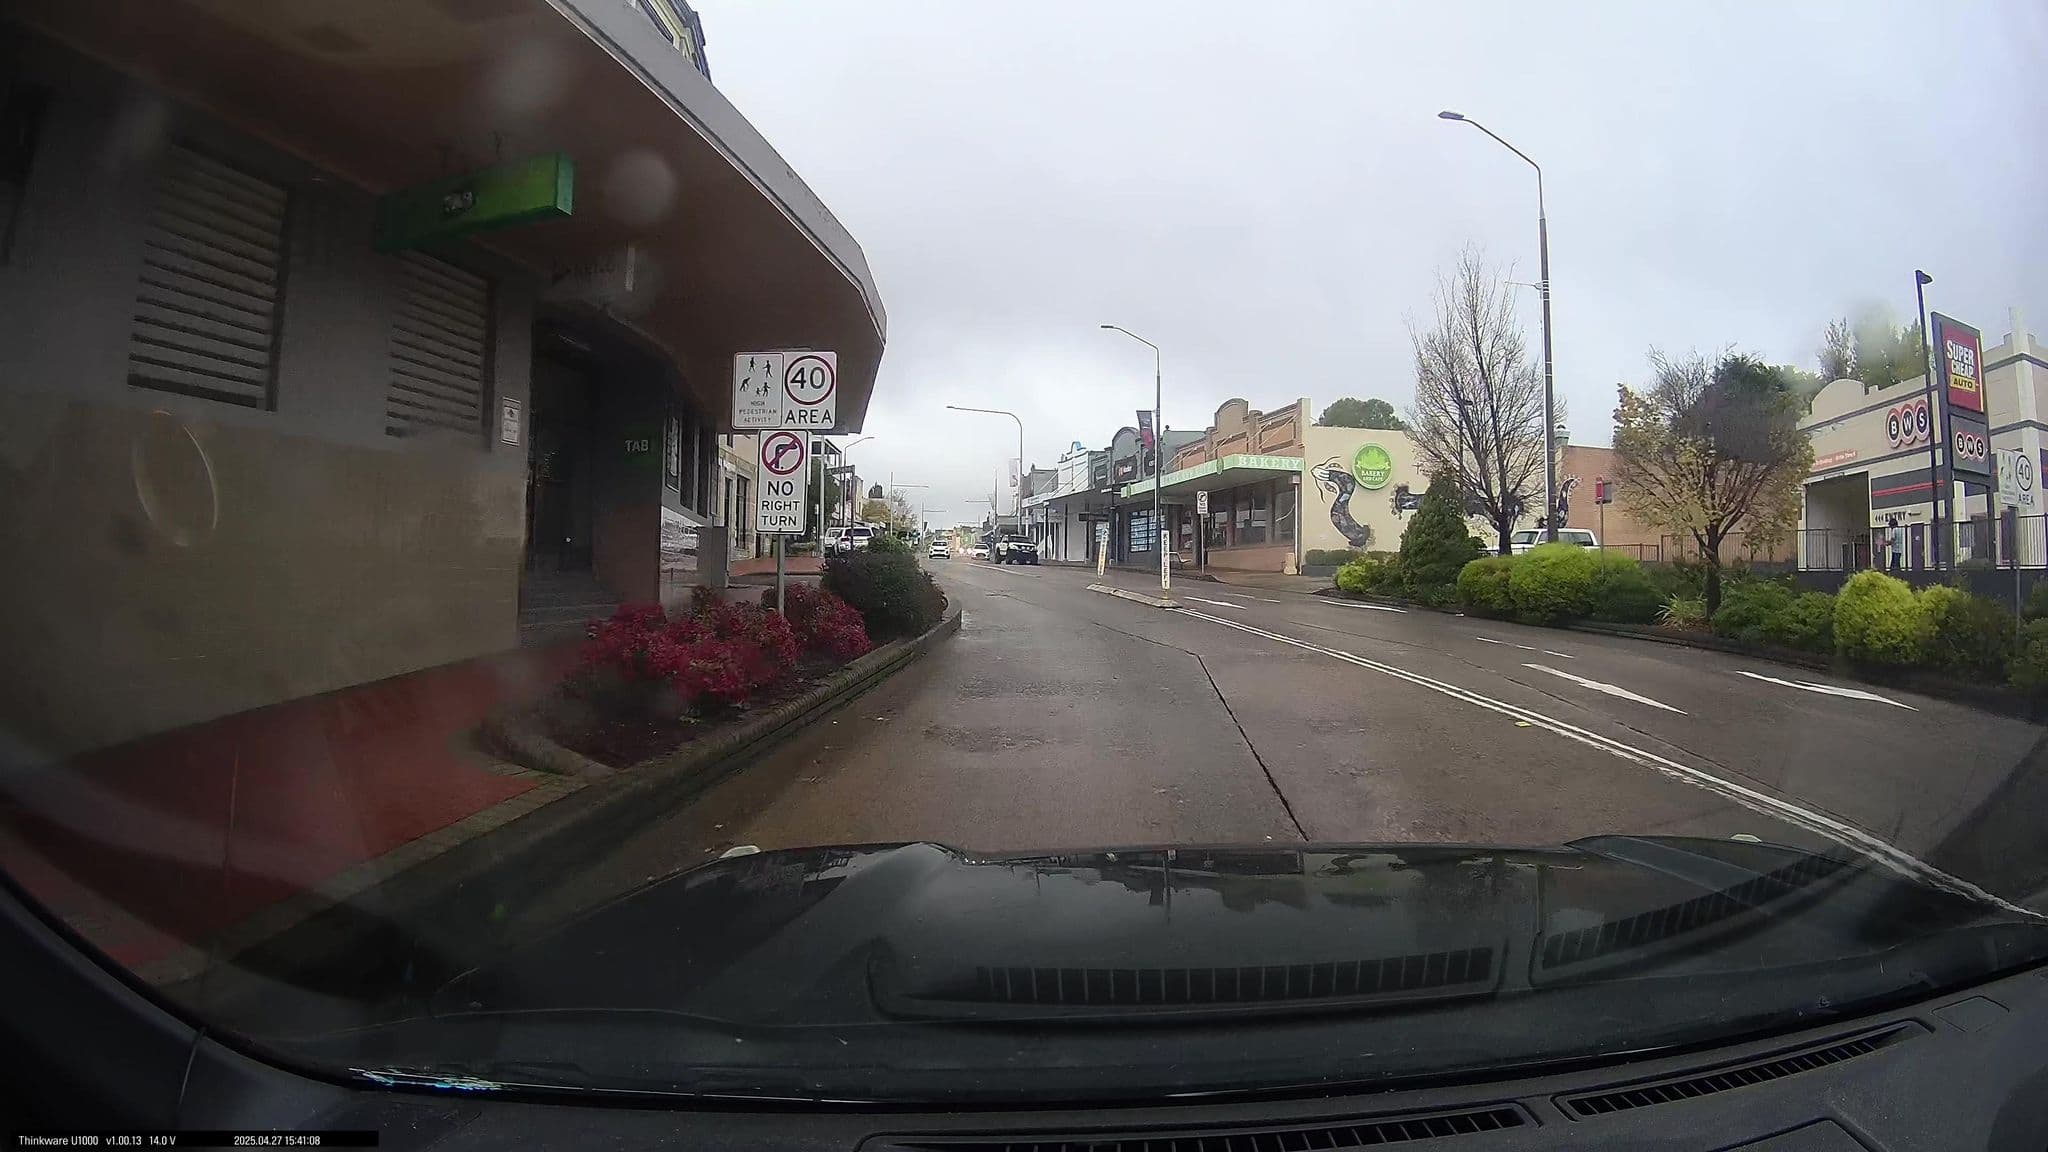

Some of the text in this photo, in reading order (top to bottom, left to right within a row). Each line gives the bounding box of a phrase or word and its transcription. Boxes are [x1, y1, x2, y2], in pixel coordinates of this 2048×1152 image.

[1946, 339, 1975, 366] SUPER
[1951, 359, 1974, 378] CHEAP
[790, 366, 826, 390] 40
[1953, 377, 1974, 389] AUTO
[784, 408, 833, 425] AREA
[1891, 411, 1925, 435] BWS
[624, 438, 649, 453] TAB
[1957, 437, 1984, 456] BWS
[1238, 456, 1300, 469] BAKERY
[2018, 463, 2031, 481] 40
[767, 480, 794, 497] NO
[761, 500, 801, 511] RIGHT
[2018, 493, 2034, 504] AREA
[761, 515, 797, 527] TURN
